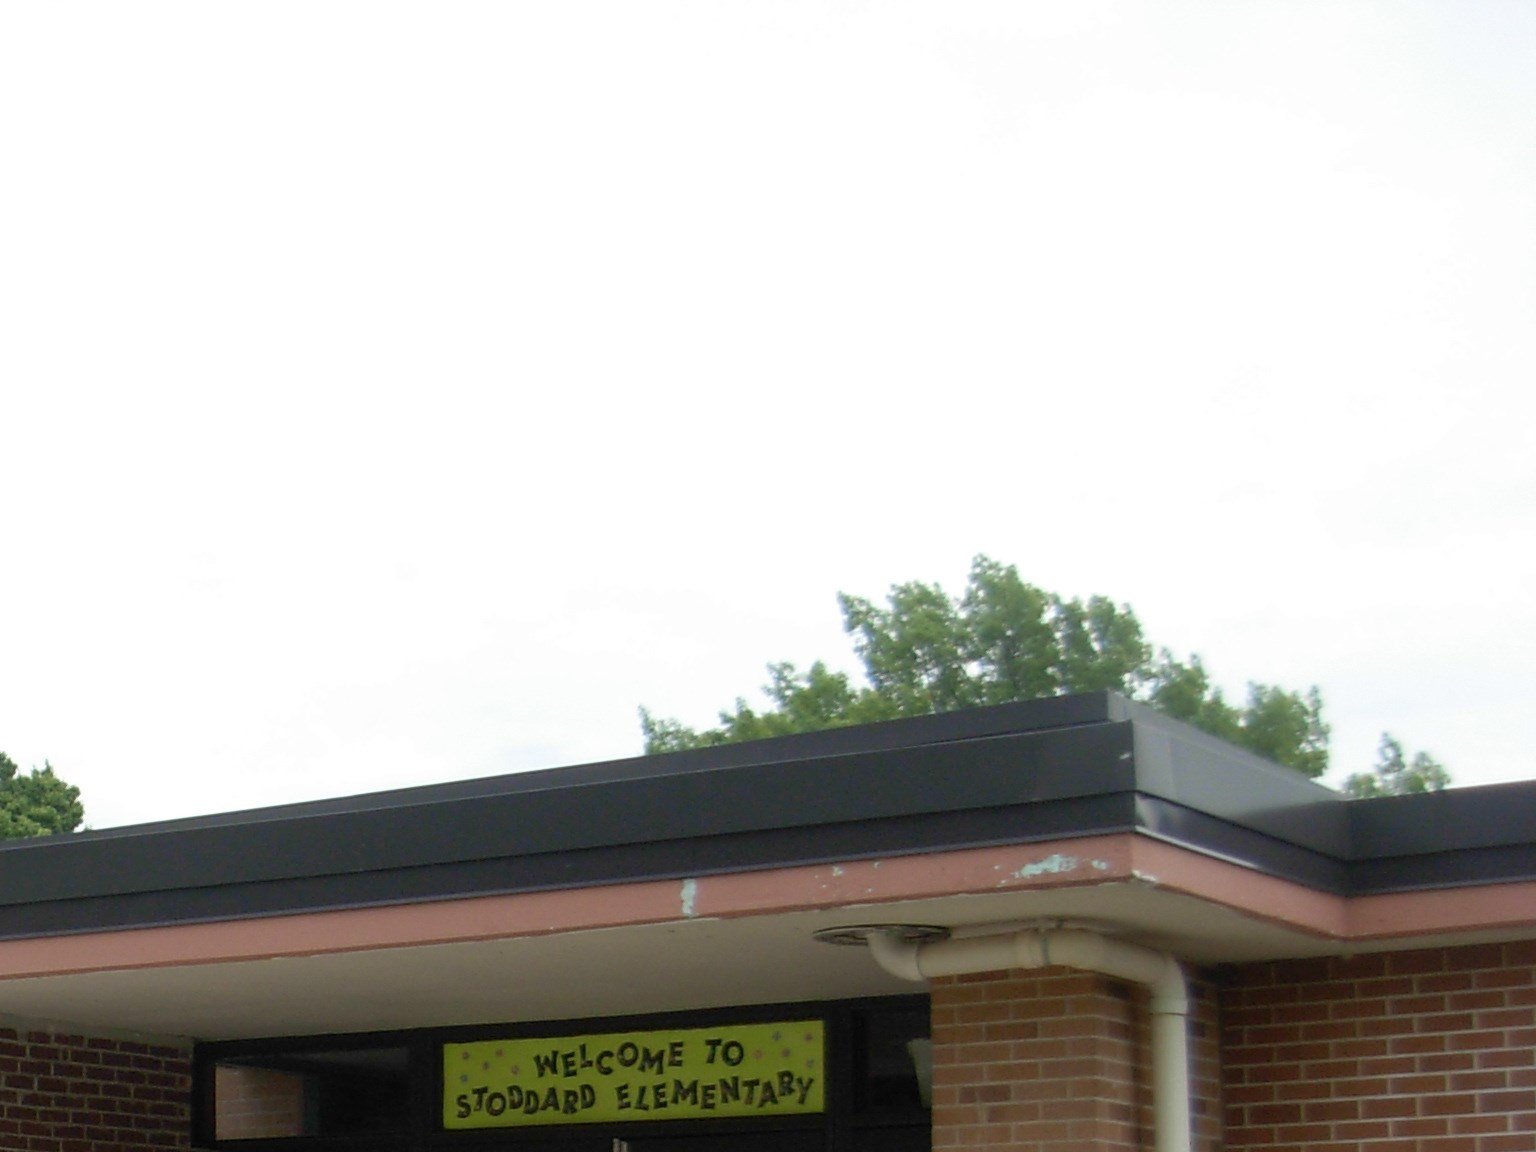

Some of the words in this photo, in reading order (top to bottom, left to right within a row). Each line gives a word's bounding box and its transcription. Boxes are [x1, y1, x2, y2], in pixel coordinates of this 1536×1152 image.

[533, 1041, 685, 1078] WELCOME
[705, 1038, 745, 1067] TO
[456, 1083, 596, 1119] STODDARD
[616, 1070, 815, 1111] ELEMENTARY
